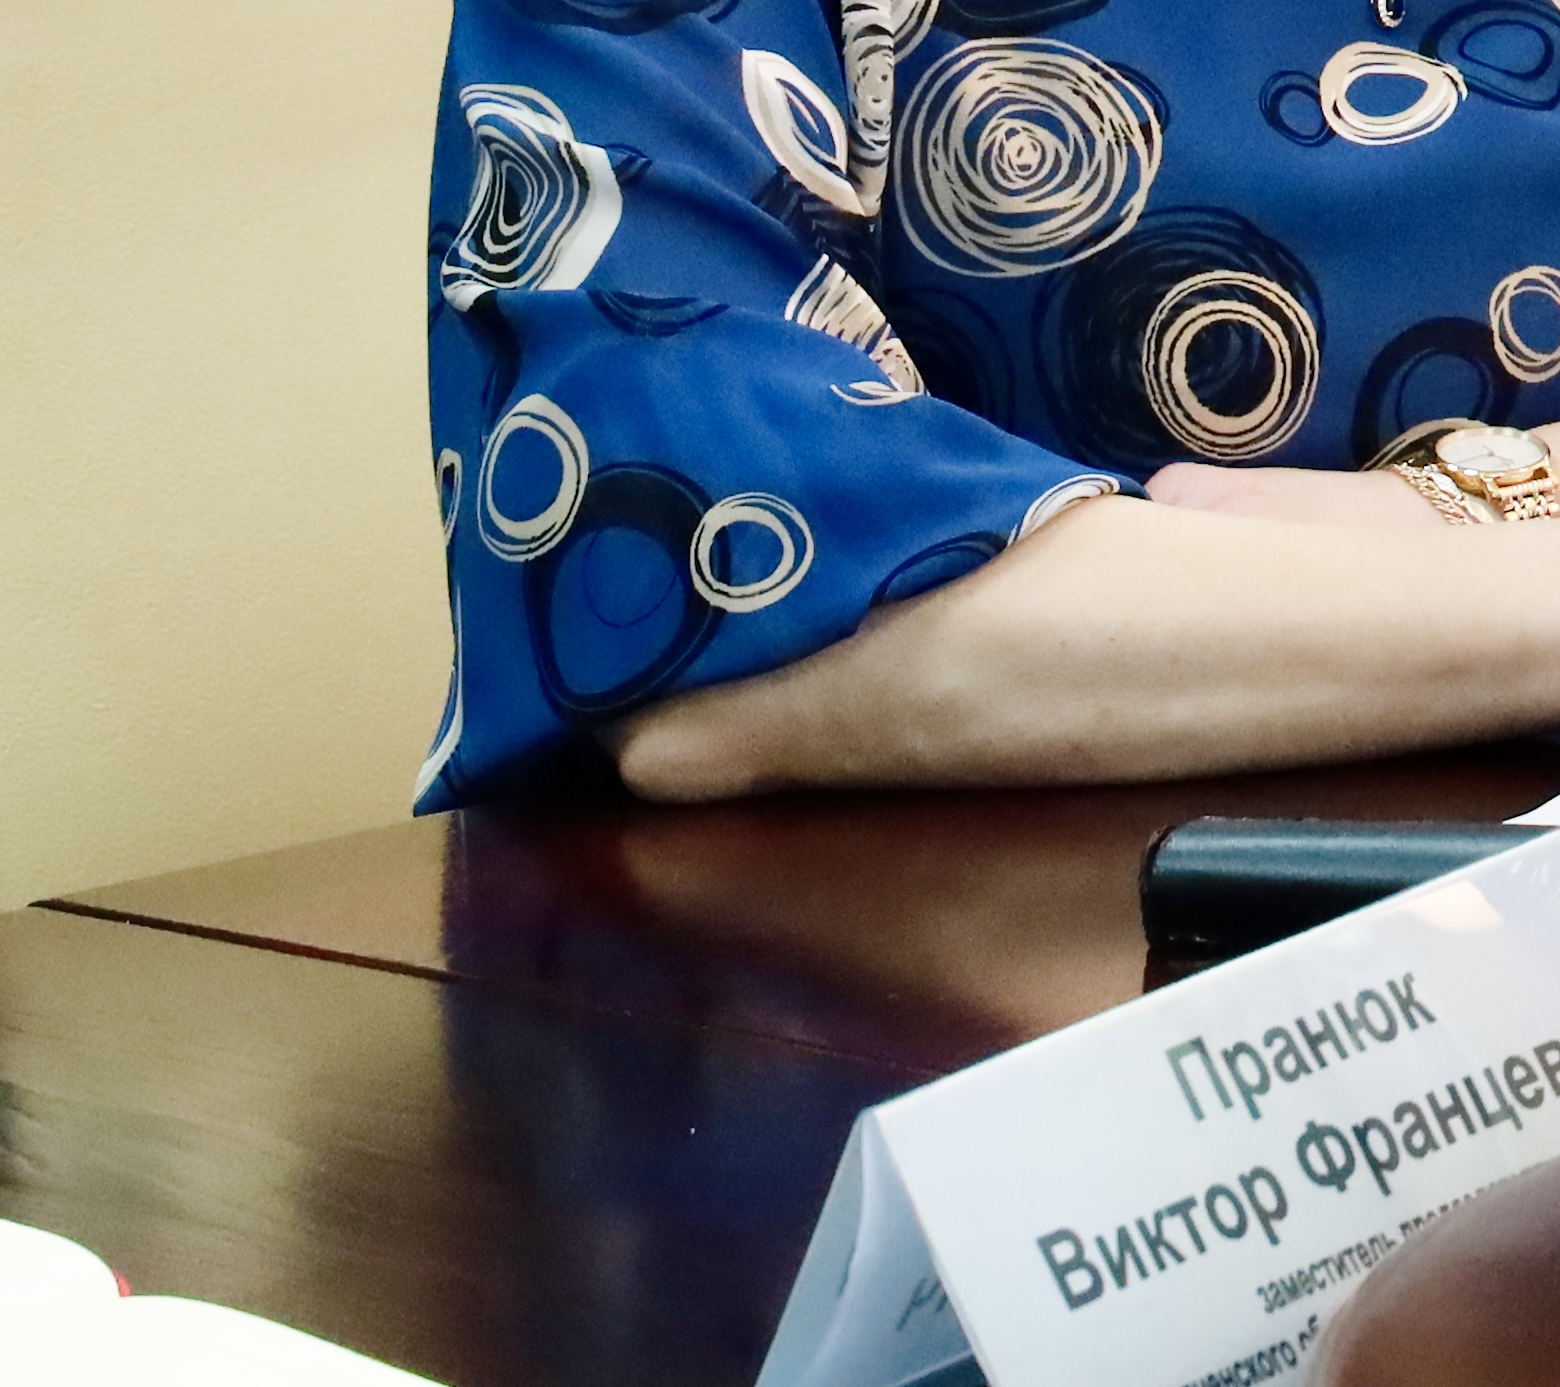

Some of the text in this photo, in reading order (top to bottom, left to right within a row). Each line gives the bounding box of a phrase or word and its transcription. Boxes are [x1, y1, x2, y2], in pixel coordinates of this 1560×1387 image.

[1165, 969, 1437, 1123] Пранюк
[1036, 1165, 1289, 1311] Виктор
[1256, 1233, 1397, 1315] заместитель
